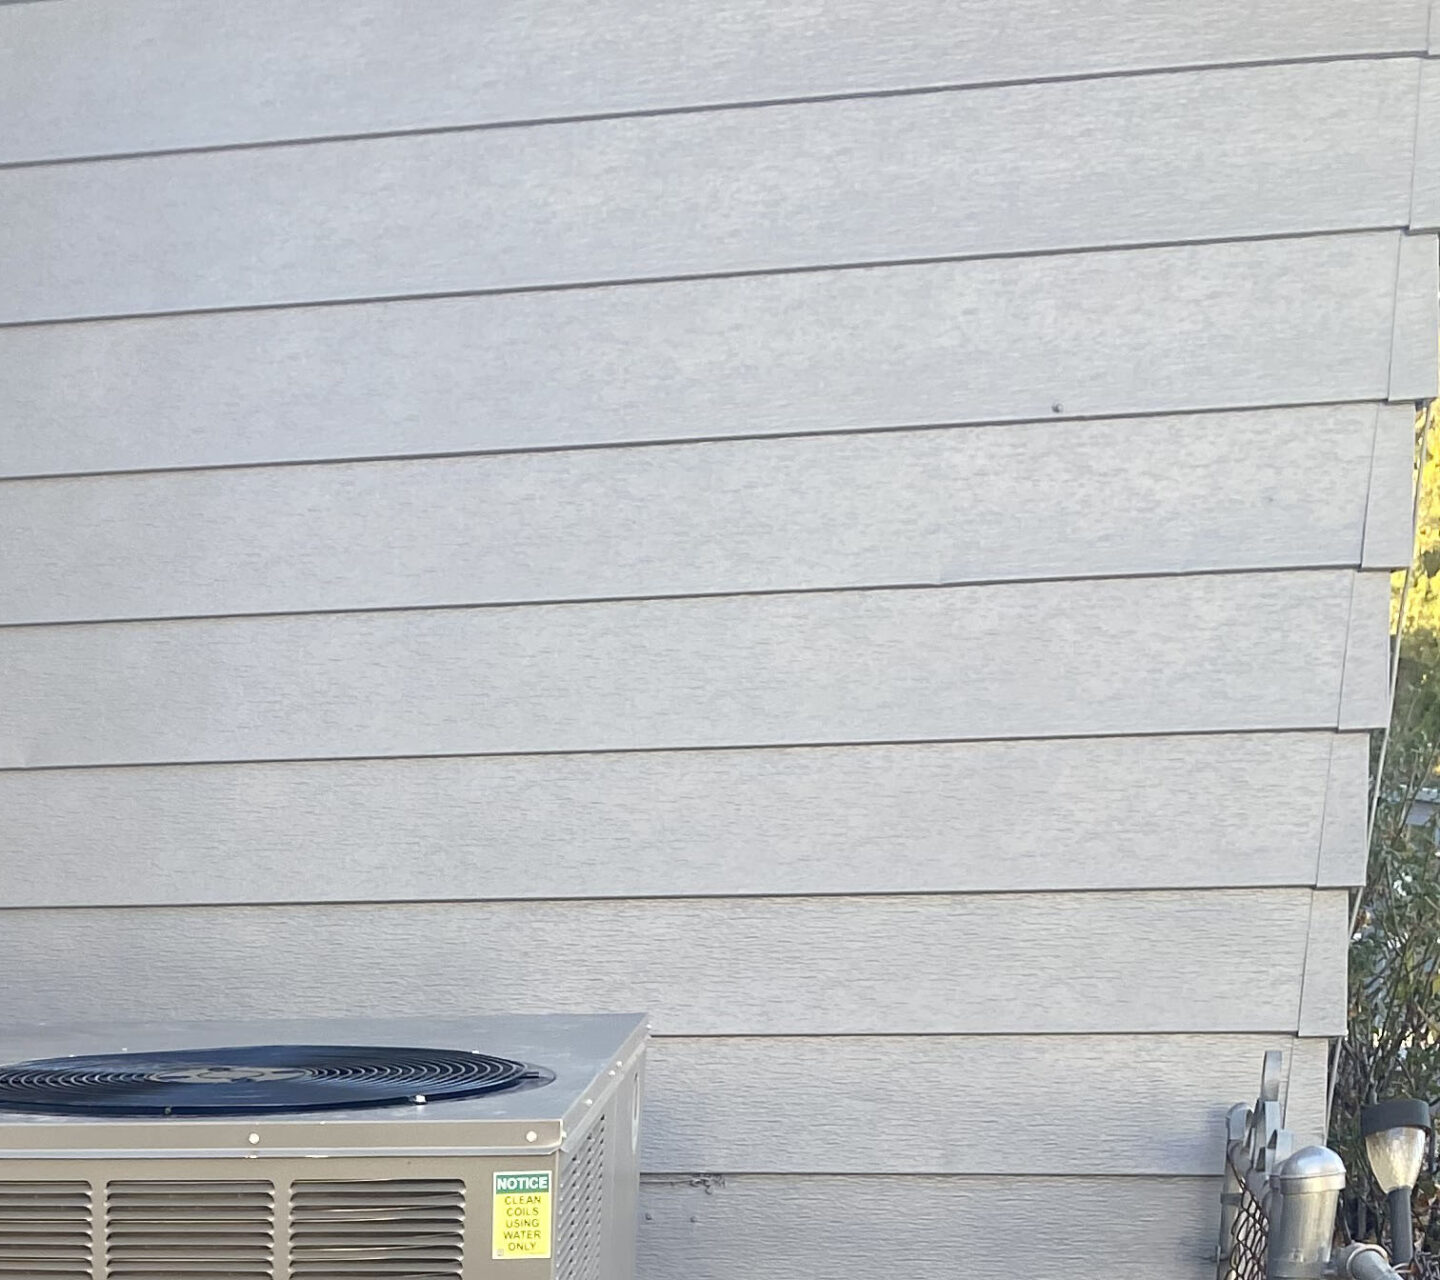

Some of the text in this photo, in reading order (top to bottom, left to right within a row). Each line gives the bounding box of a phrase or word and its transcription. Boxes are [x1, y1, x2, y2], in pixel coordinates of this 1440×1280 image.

[497, 1177, 547, 1190] NOTICE
[504, 1196, 541, 1205] CLEAN
[506, 1207, 539, 1216] COILS
[506, 1219, 539, 1228] USING
[503, 1230, 541, 1239] WATER
[508, 1242, 536, 1251] ONLY
